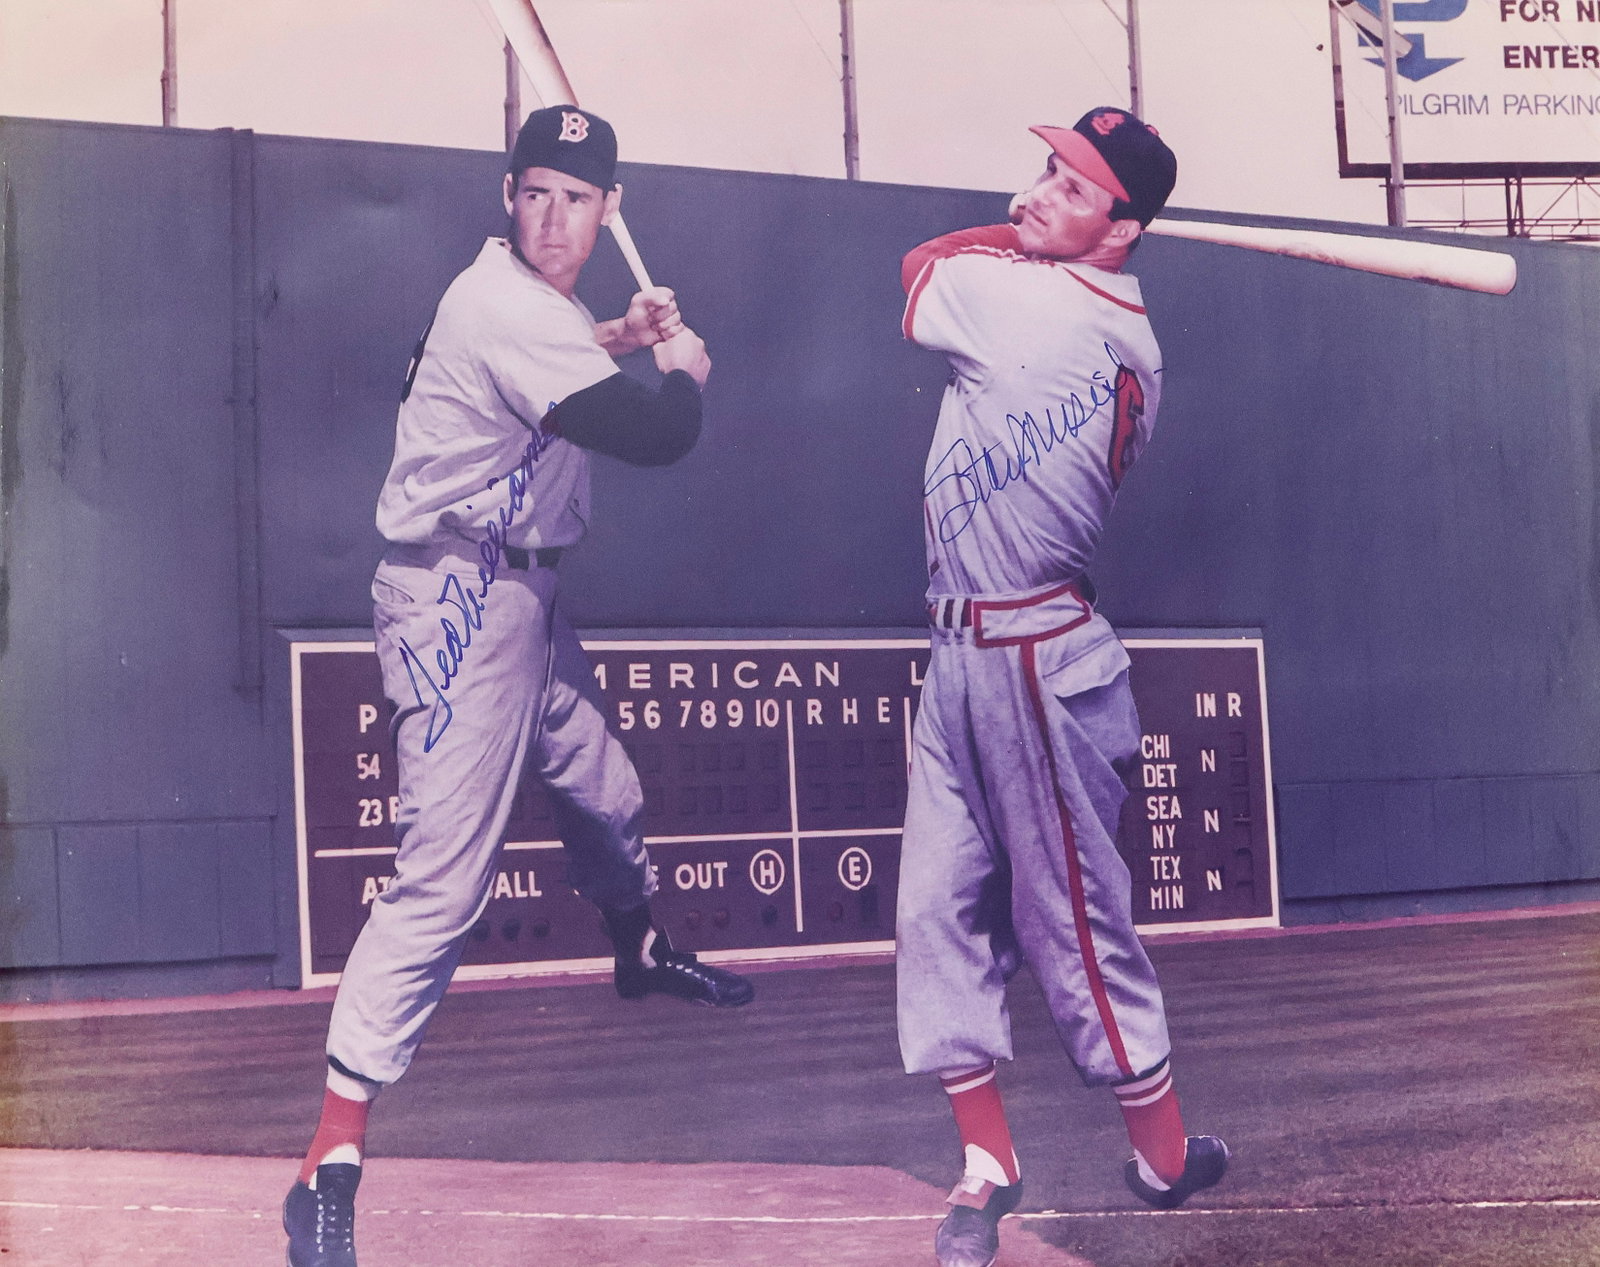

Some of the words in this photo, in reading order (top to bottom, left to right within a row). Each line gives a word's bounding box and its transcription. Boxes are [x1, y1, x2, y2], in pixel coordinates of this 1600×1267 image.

[1499, 0, 1560, 23] FOR
[1577, 0, 1600, 22] N
[1398, 93, 1489, 115] ILGRIM
[559, 111, 589, 143] B
[594, 661, 839, 690] ERICAN
[807, 699, 823, 725] R
[842, 698, 858, 724] H
[878, 697, 890, 723] E
[1196, 693, 1216, 717] IN
[1227, 692, 1242, 717] R
[359, 704, 378, 733] P
[1141, 734, 1170, 759] CHI
[357, 753, 380, 780] 54
[1201, 749, 1216, 772] N
[1143, 764, 1177, 788] DET
[358, 798, 383, 827] 23
[1147, 795, 1182, 820] SEA
[1204, 809, 1220, 833] N
[1152, 824, 1175, 849] NY
[491, 871, 542, 899] ALL
[675, 862, 728, 890] OUT
[759, 860, 776, 885] H
[848, 857, 861, 882] E
[1150, 856, 1181, 880] TEX
[1206, 870, 1222, 891] N
[1150, 885, 1184, 910] MIN
